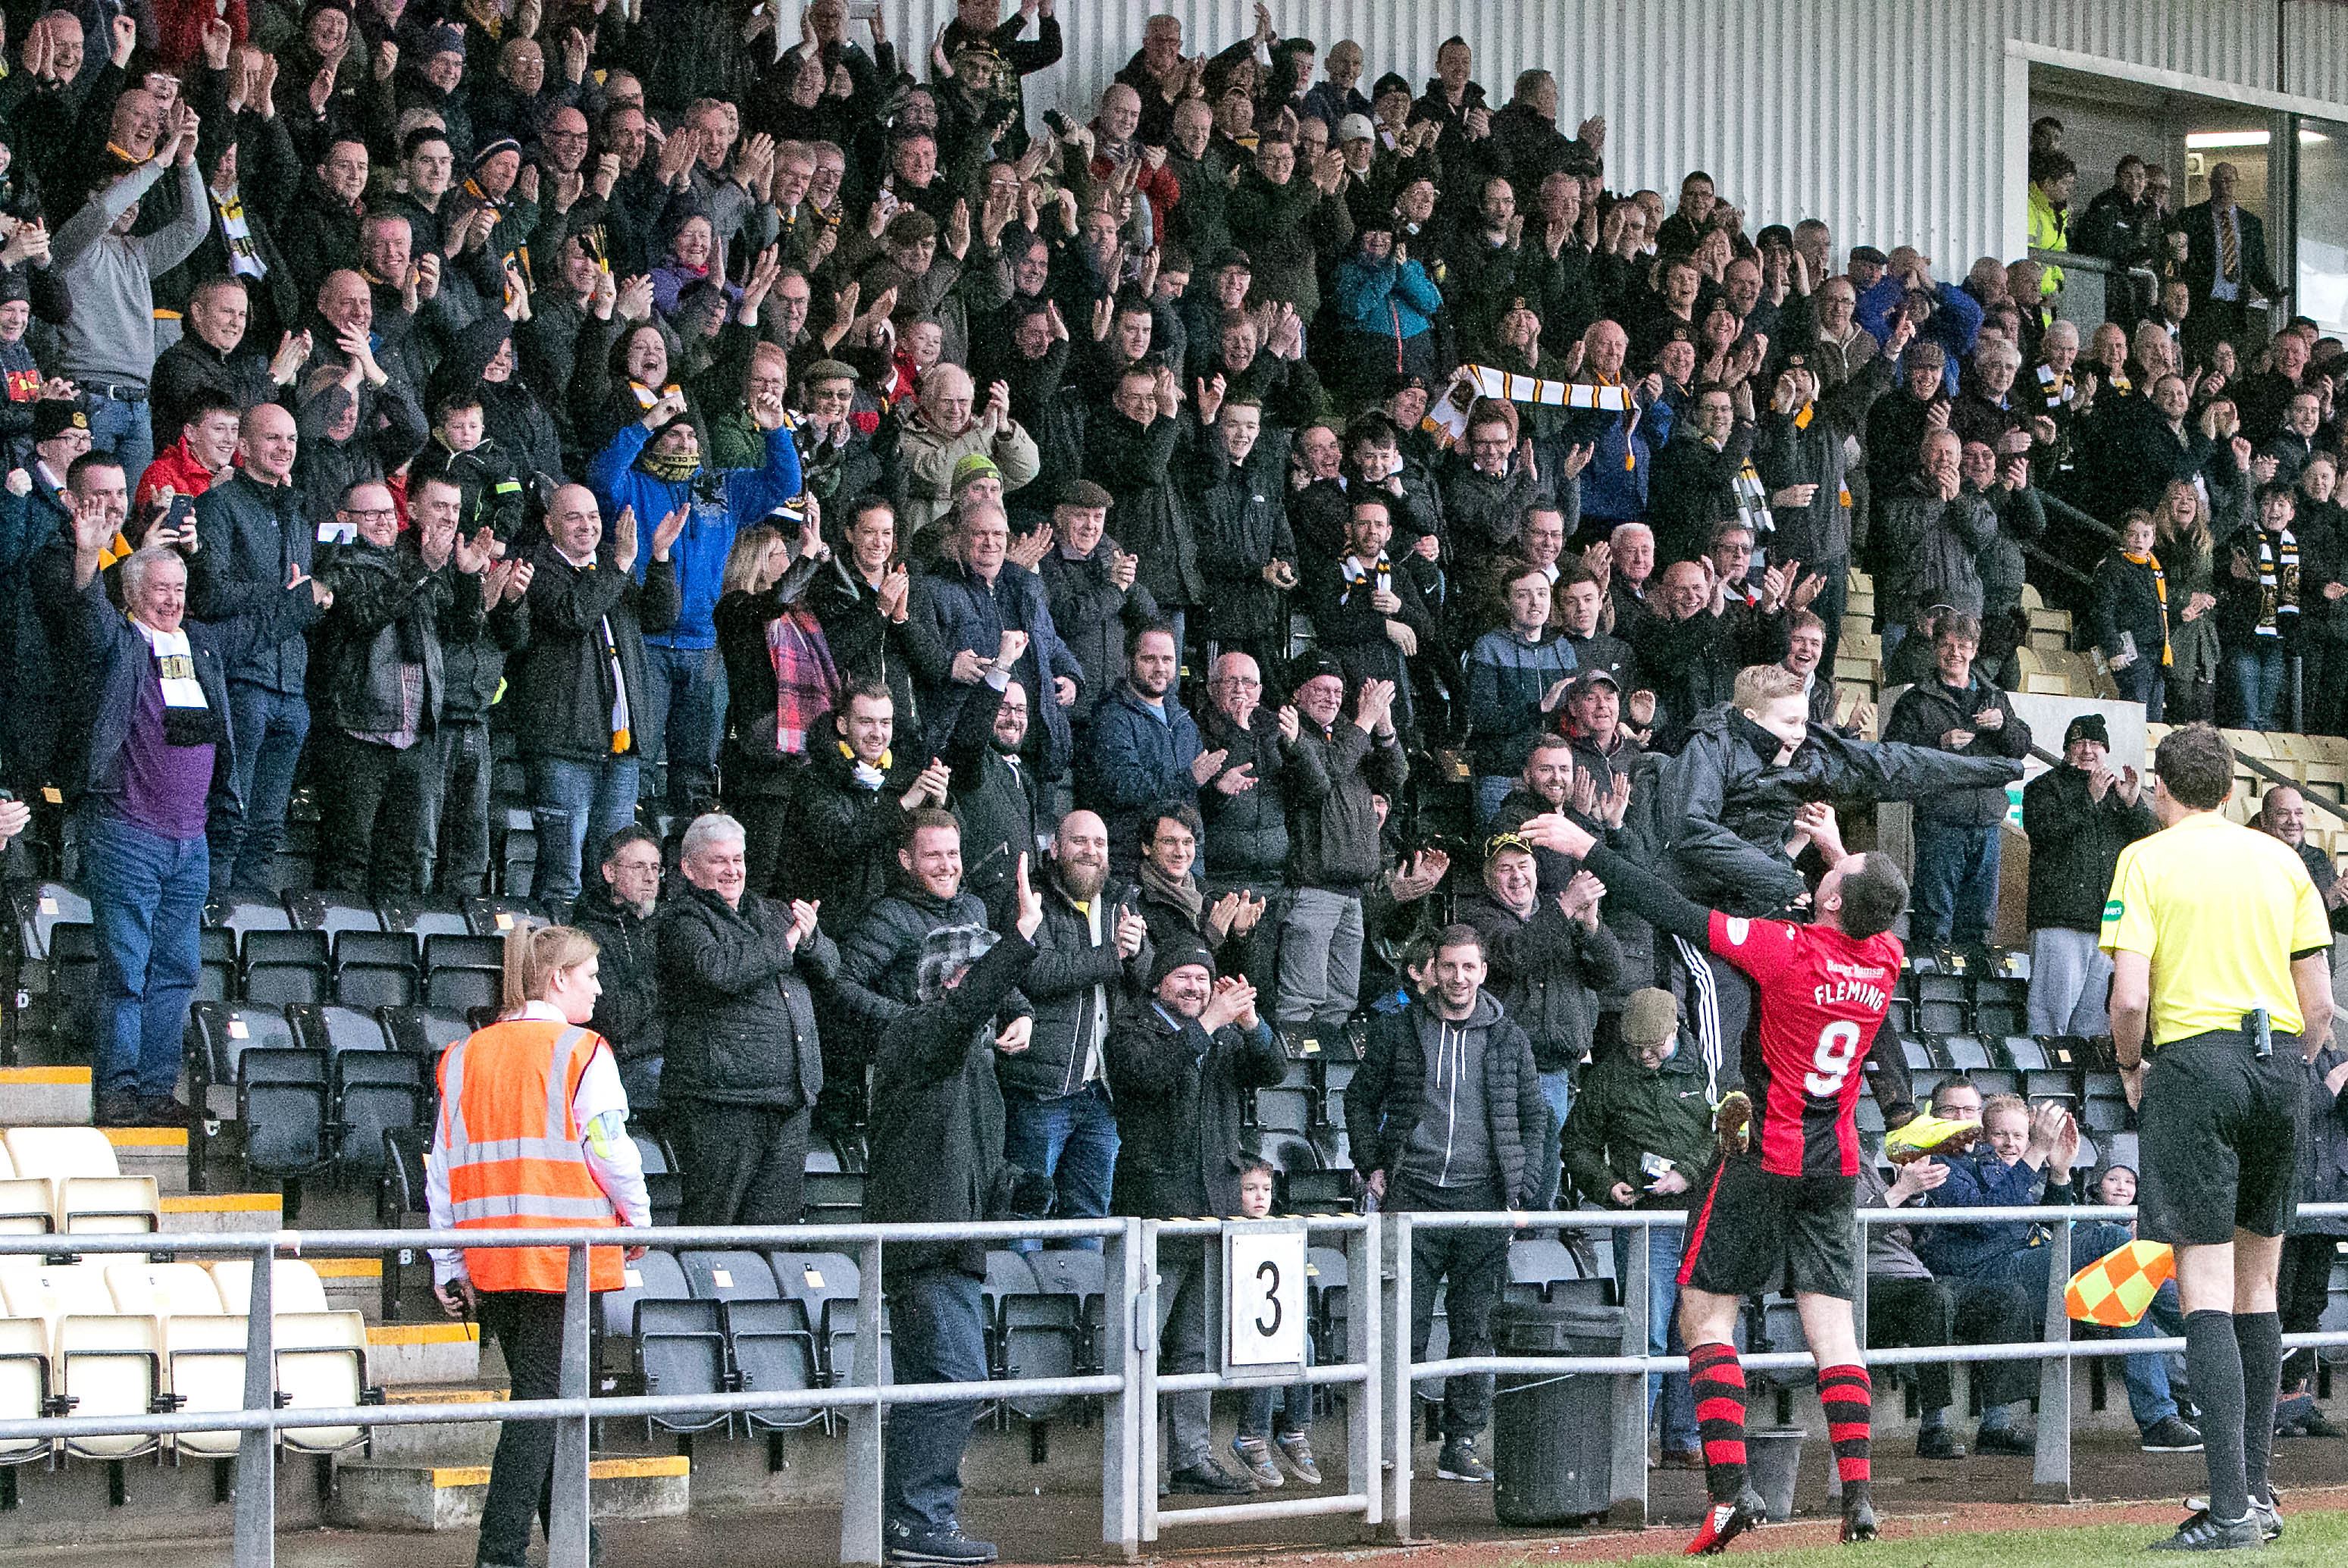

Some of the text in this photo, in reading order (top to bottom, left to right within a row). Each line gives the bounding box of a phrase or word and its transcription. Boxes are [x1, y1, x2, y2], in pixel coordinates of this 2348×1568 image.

[17, 993, 29, 1008] D
[1814, 981, 1886, 1011] FLEMING
[1805, 1020, 1861, 1097] 9
[399, 1248, 412, 1265] B
[1255, 1260, 1282, 1337] 3
